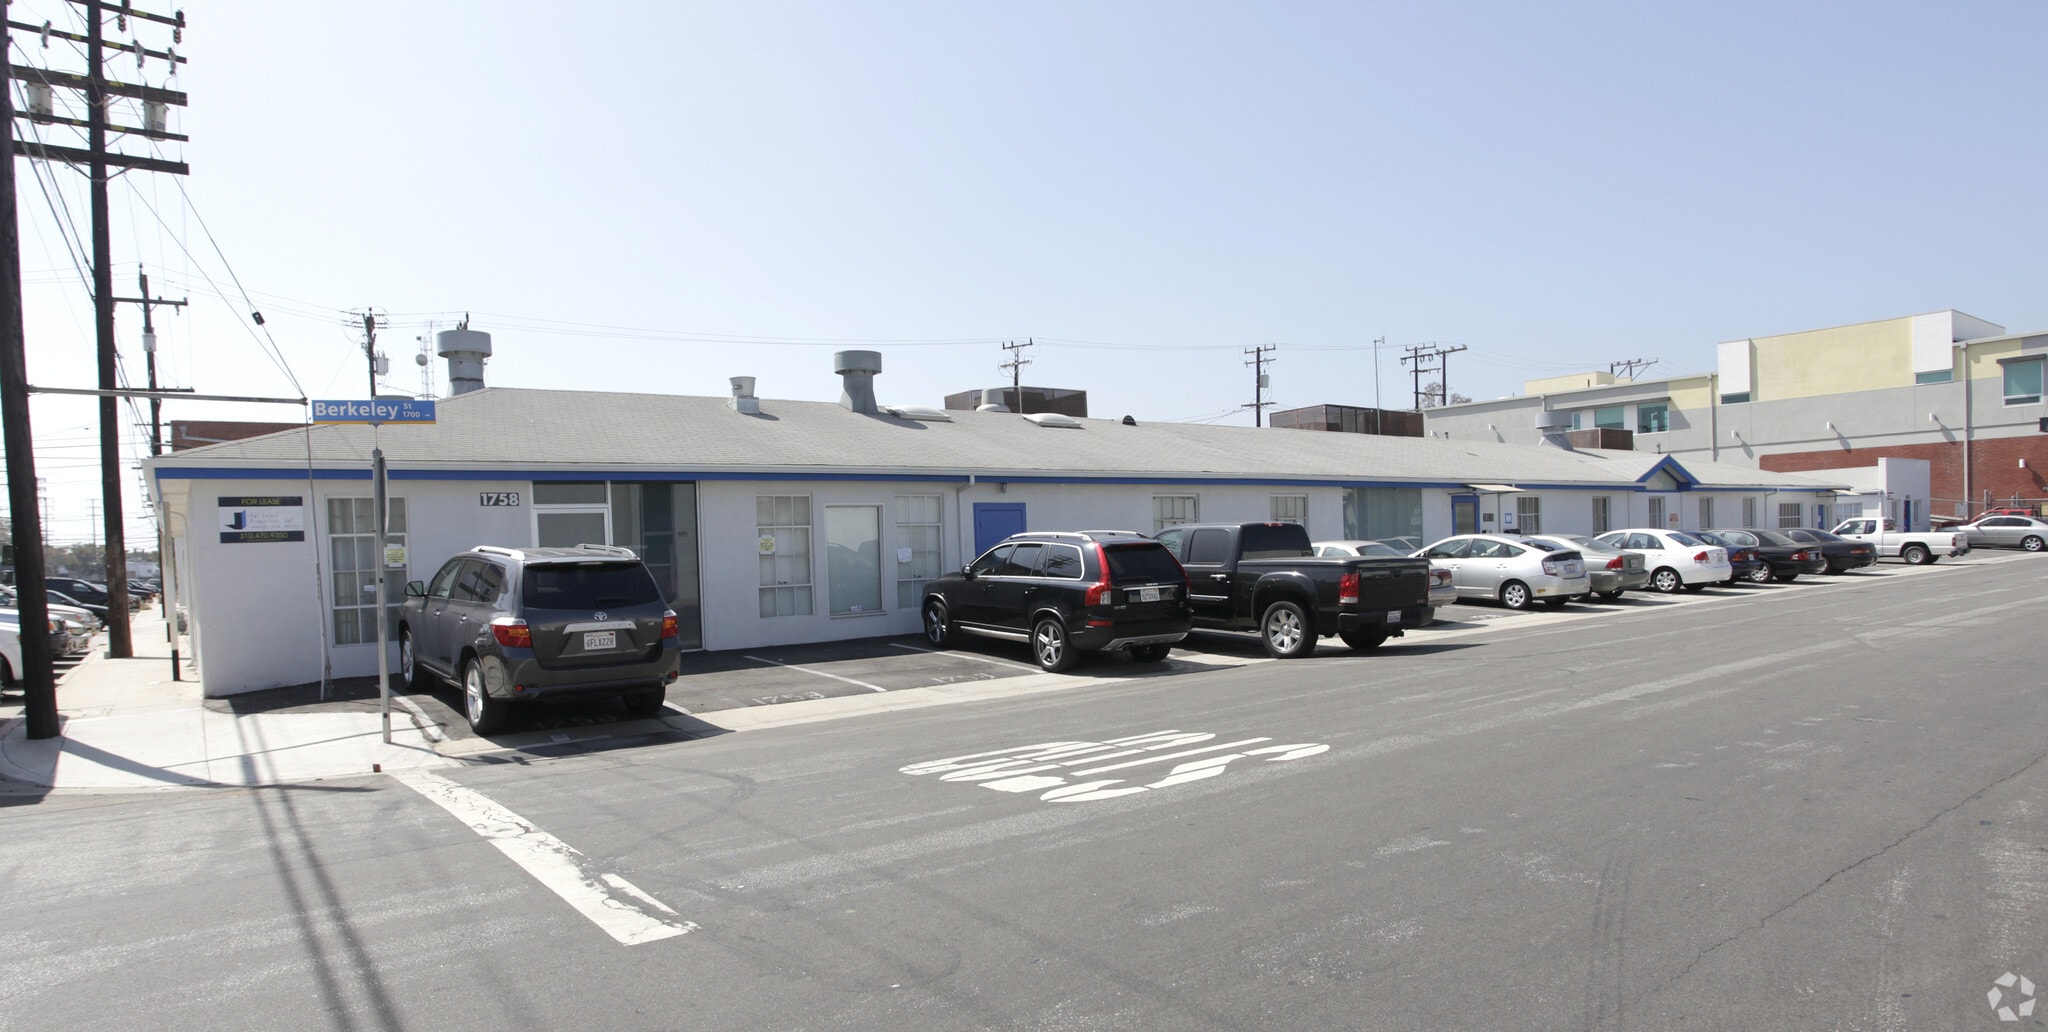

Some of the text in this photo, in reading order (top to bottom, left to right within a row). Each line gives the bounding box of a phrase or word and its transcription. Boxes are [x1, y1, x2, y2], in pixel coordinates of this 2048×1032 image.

[315, 401, 399, 420] Berkeley
[403, 402, 412, 410] St
[481, 493, 519, 506] 1758
